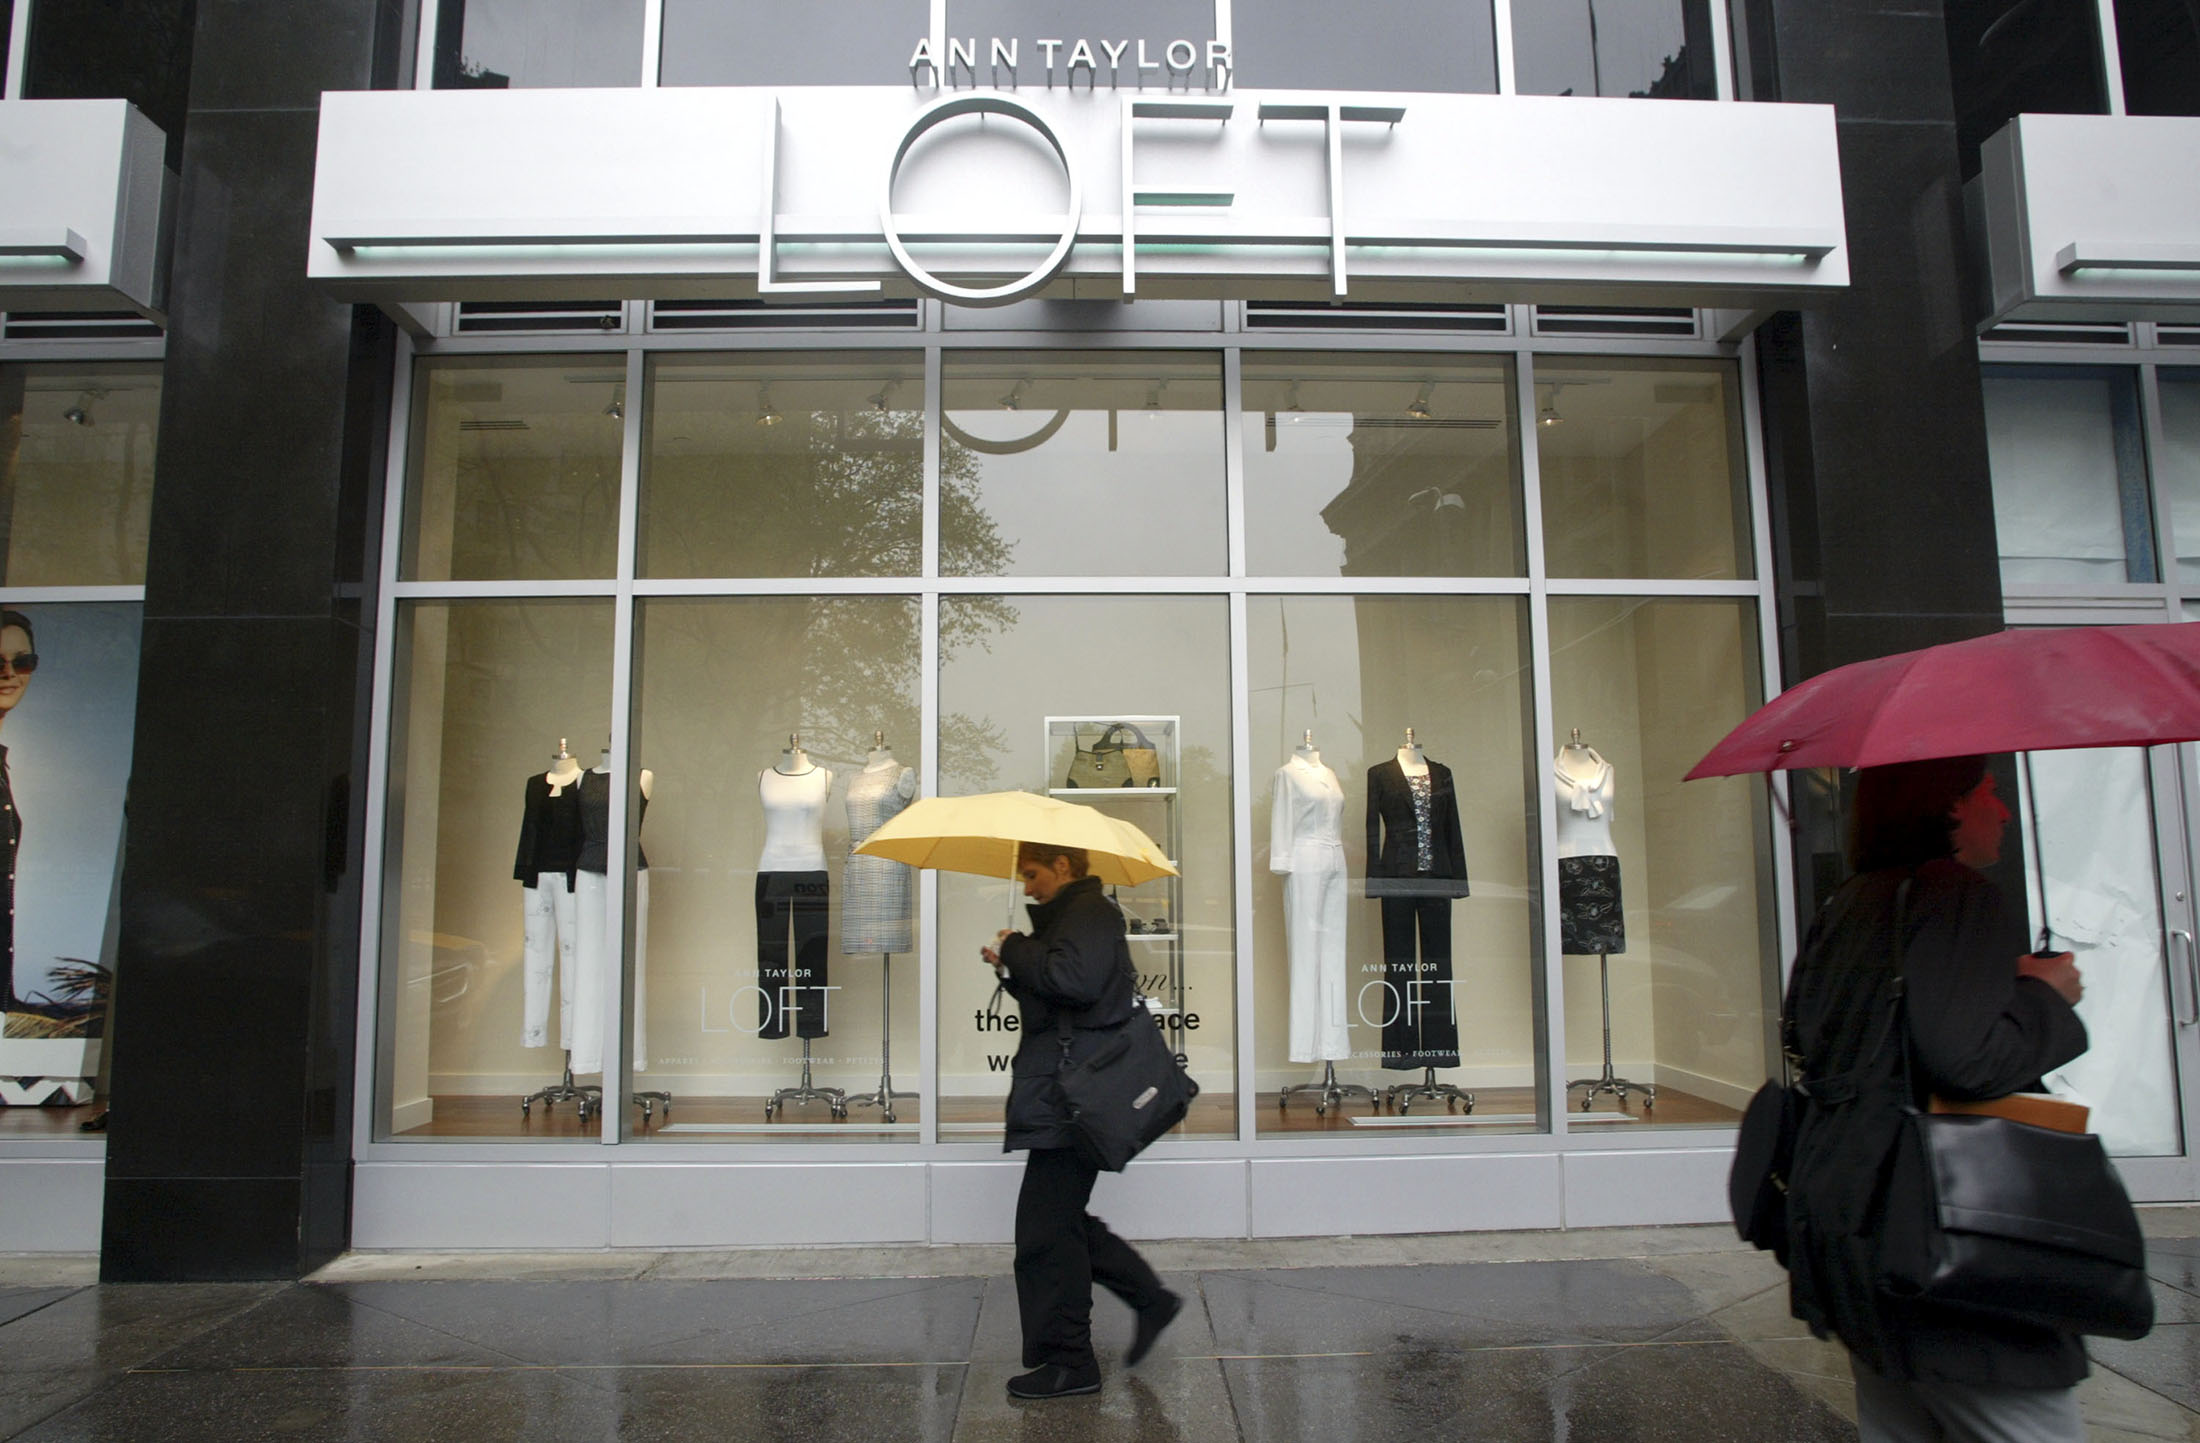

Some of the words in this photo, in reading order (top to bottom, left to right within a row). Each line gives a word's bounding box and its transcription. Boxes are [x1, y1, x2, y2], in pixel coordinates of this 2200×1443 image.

[909, 37, 1019, 70] ANN
[1037, 38, 1233, 70] TAYLOR
[757, 90, 1407, 304] LOFT
[764, 968, 812, 978] TAYLOR
[1361, 963, 1388, 973] ANN
[1391, 962, 1438, 973] TAYLOR
[701, 985, 842, 1034] LOFT
[1330, 979, 1468, 1028] LOFT
[974, 1008, 1020, 1032] the
[1152, 1012, 1200, 1031] ace
[1351, 1050, 1402, 1058] CESSORIES
[1412, 1049, 1464, 1058] FOOTWEAR
